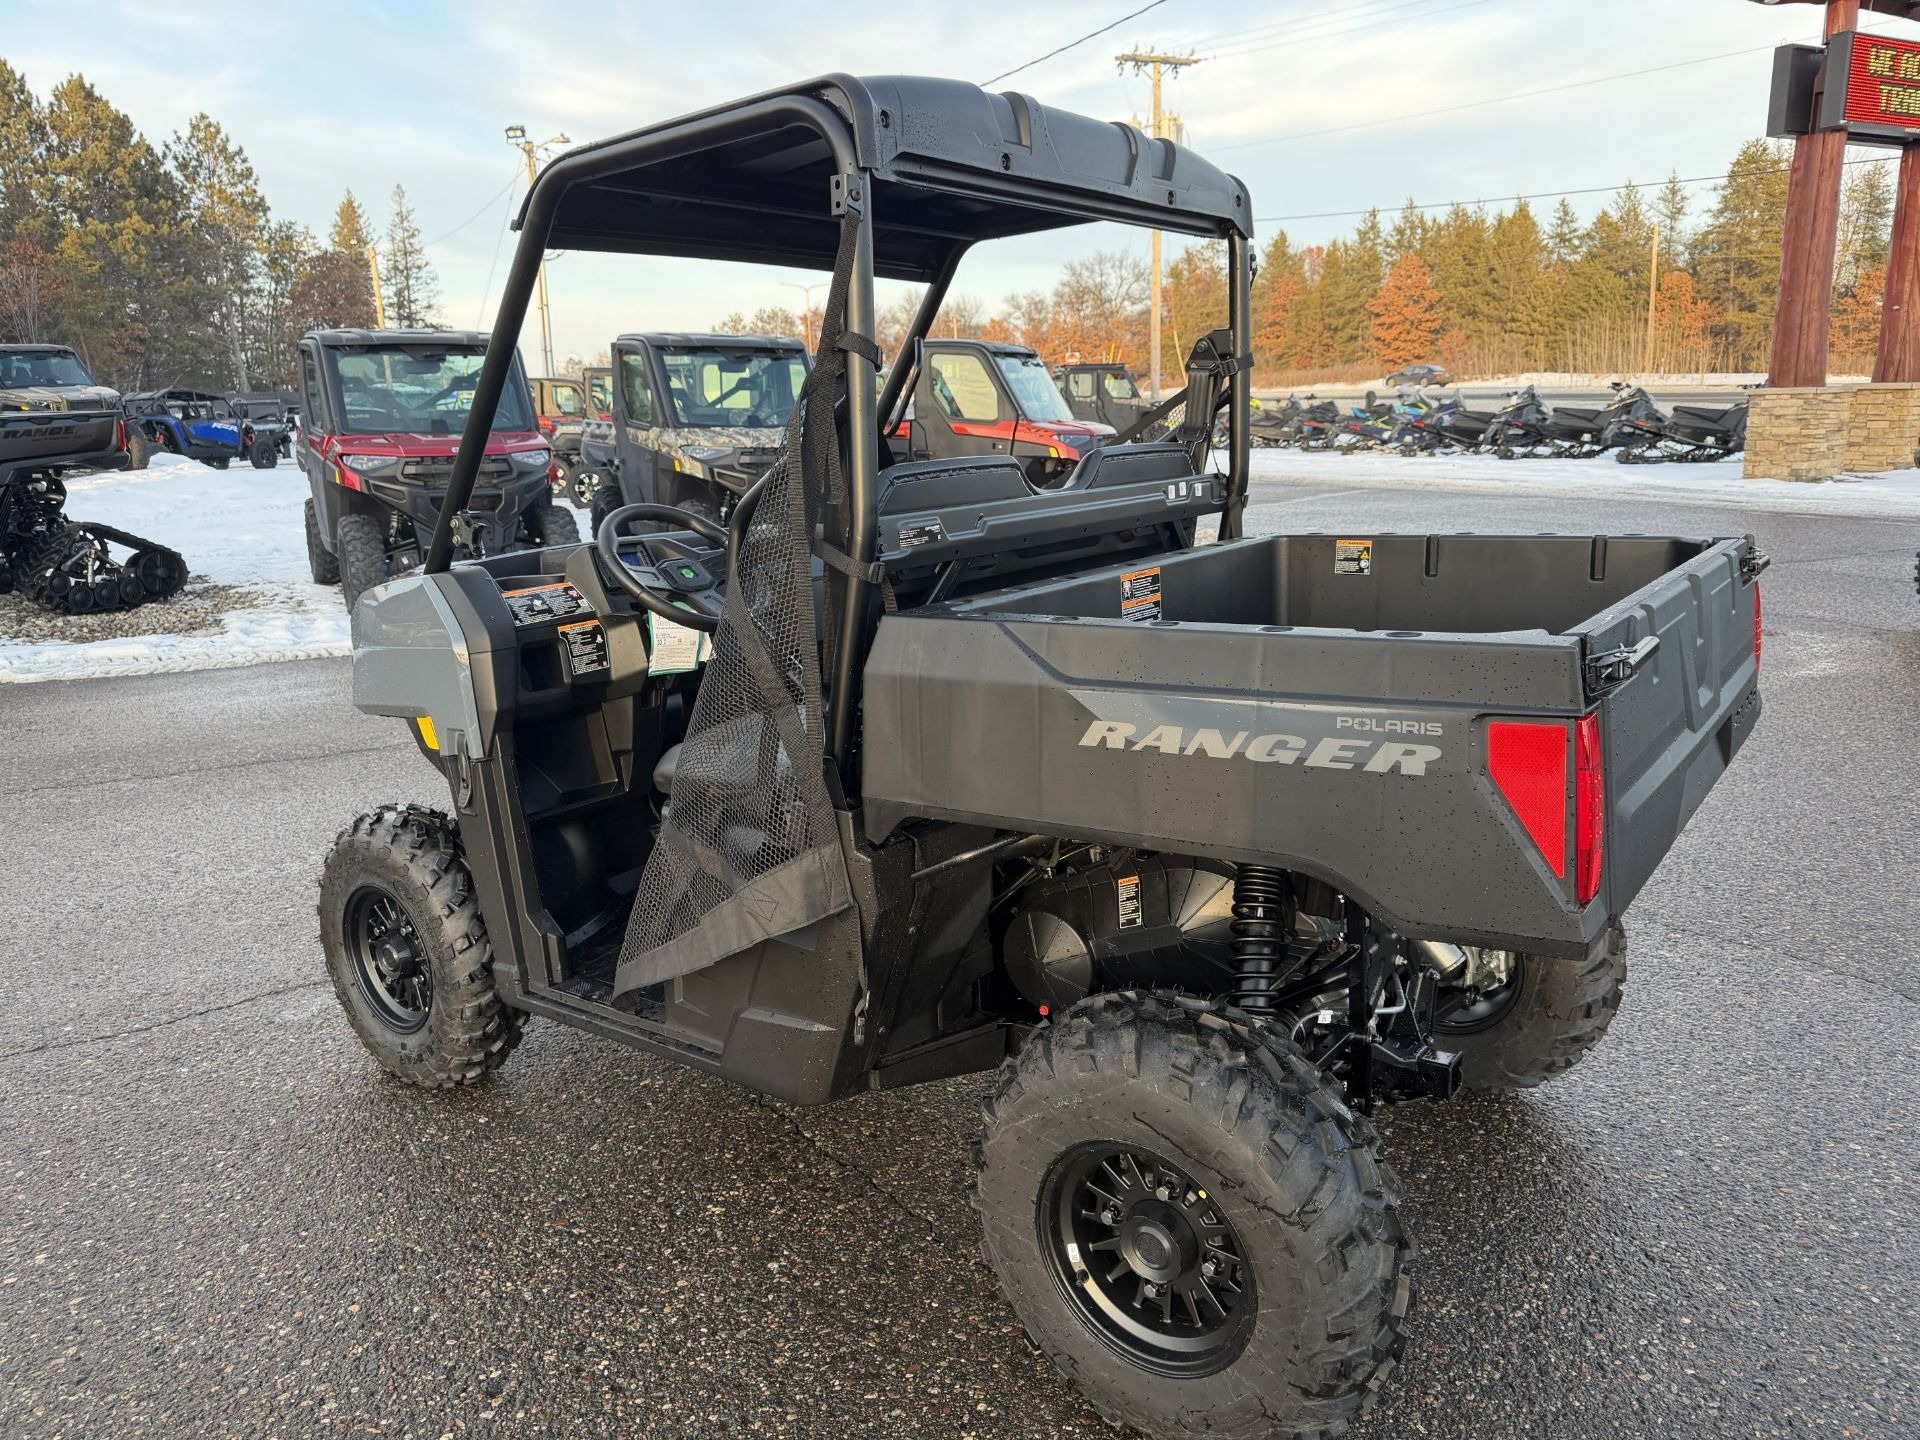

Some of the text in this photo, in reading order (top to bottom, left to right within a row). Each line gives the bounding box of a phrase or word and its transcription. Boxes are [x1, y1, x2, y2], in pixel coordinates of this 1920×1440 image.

[1869, 47, 1897, 75] WE
[1336, 716, 1444, 736] POLARIS
[1078, 720, 1442, 776] RANGER
